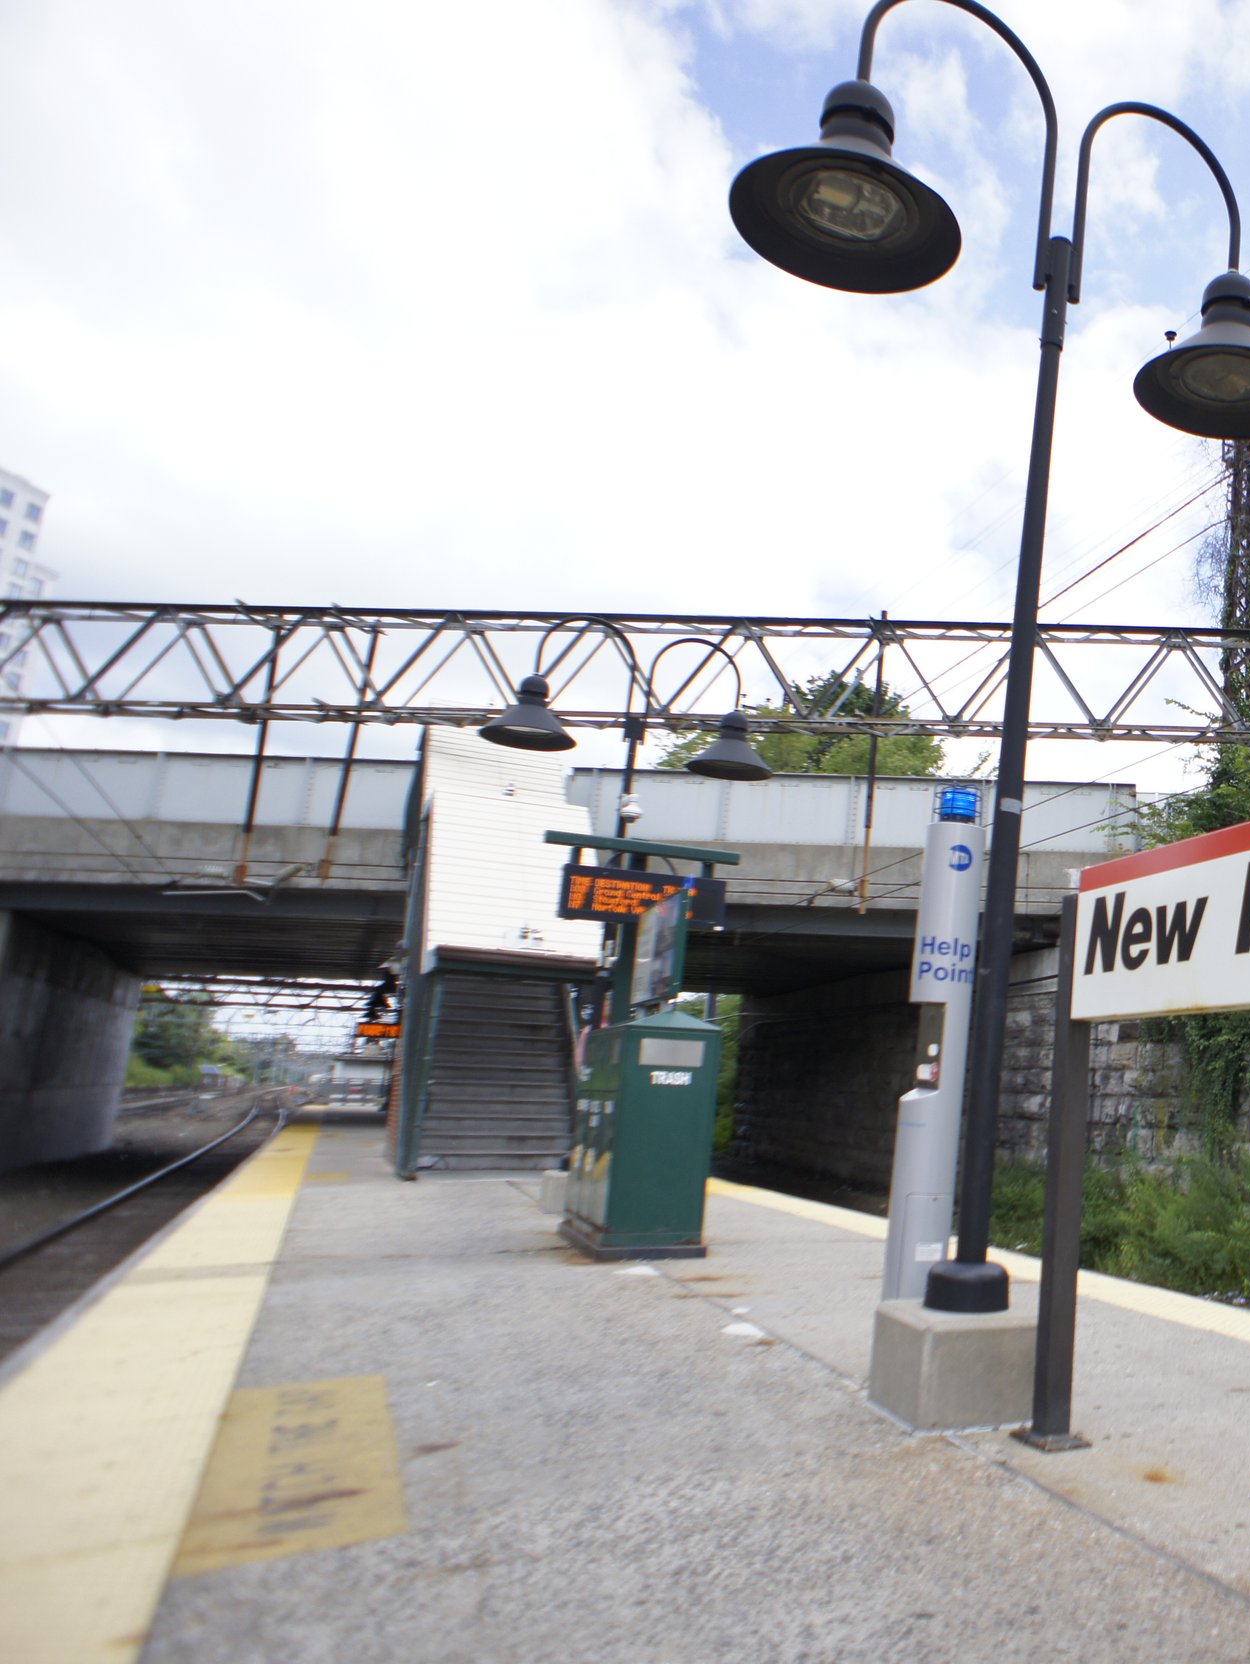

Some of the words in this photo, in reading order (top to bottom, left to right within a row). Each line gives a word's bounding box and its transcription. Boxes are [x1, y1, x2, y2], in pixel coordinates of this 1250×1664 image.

[594, 878, 654, 892] DESTINATION
[1084, 892, 1208, 976] New
[920, 936, 971, 962] Help
[649, 1070, 692, 1086] TRASH
